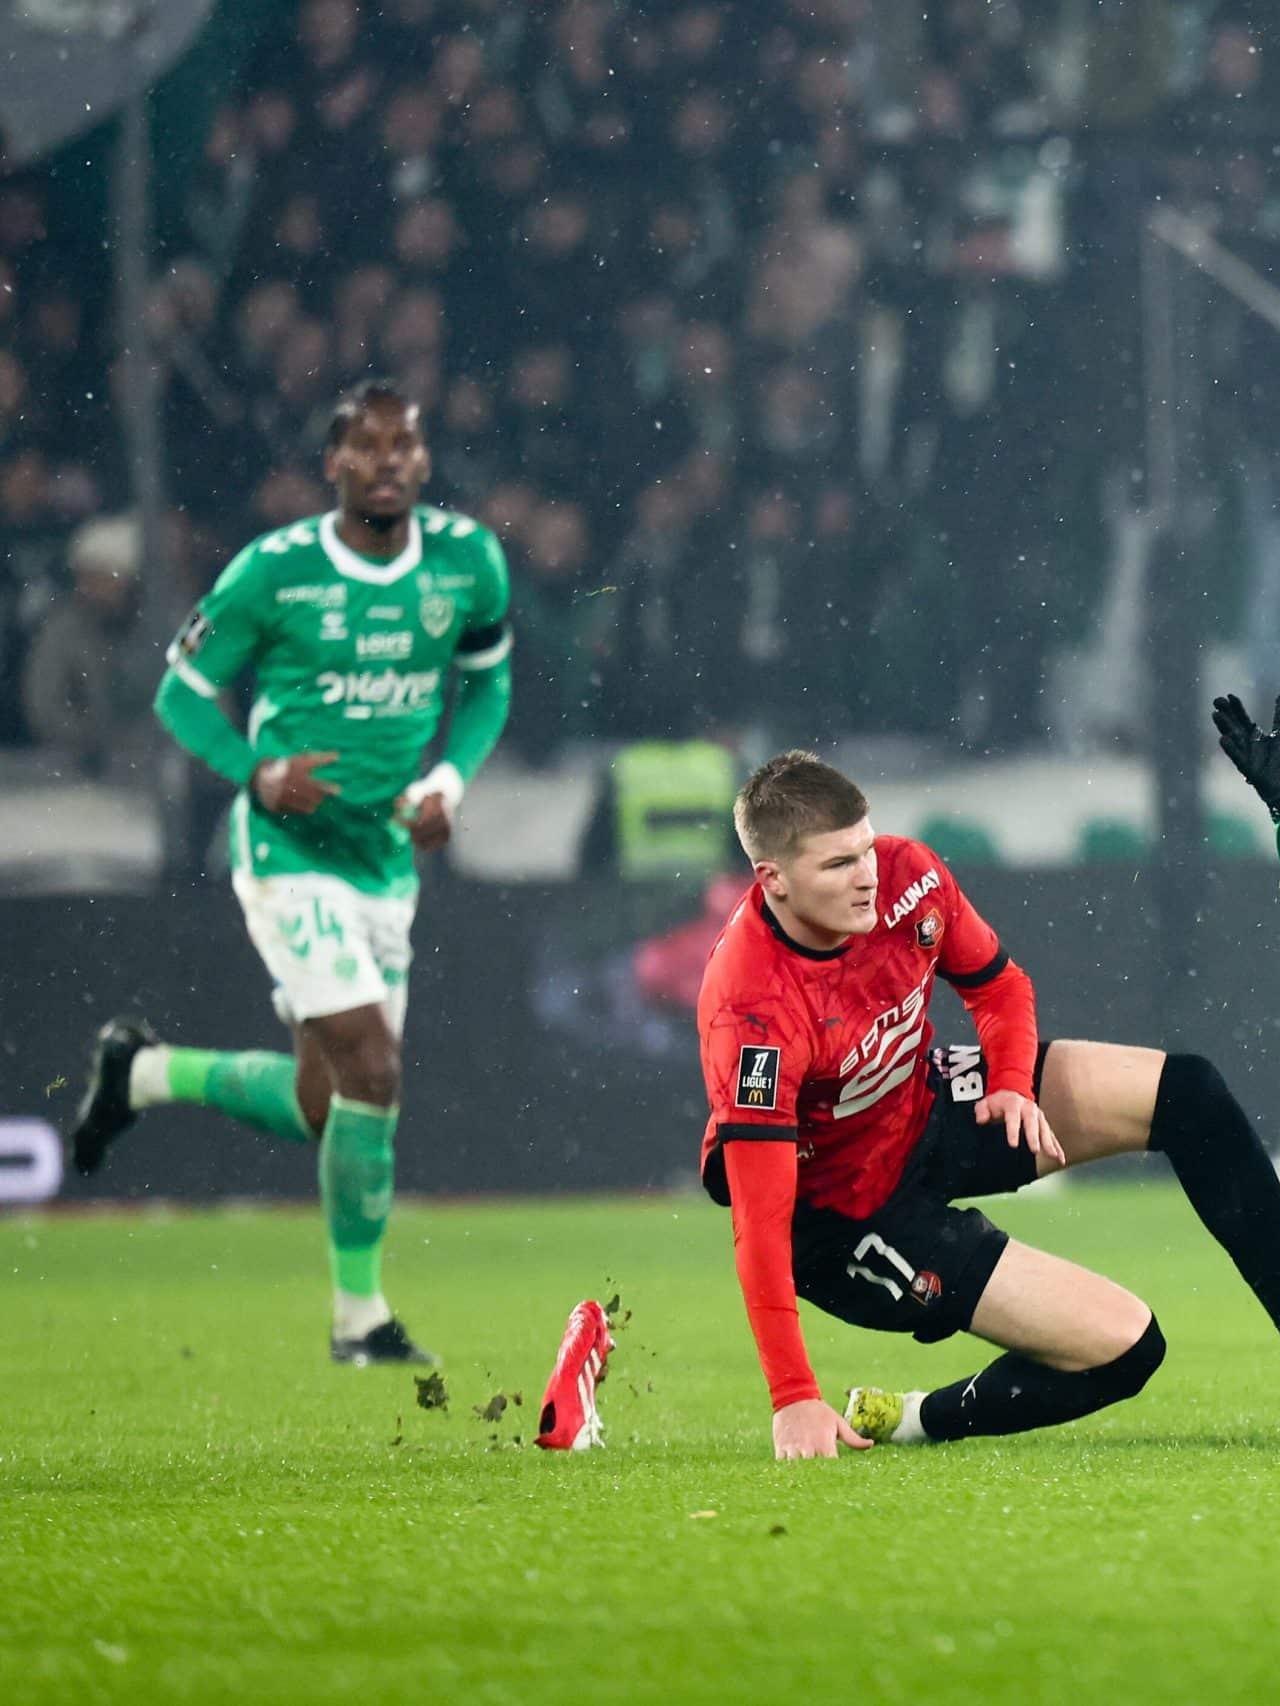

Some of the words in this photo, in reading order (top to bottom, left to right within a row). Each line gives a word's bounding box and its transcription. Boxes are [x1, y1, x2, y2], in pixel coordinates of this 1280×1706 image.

[884, 867, 941, 929] LAUNAY
[742, 1076, 767, 1089] LIGUE
[768, 1078, 772, 1089] 1
[846, 1233, 916, 1301] 17
